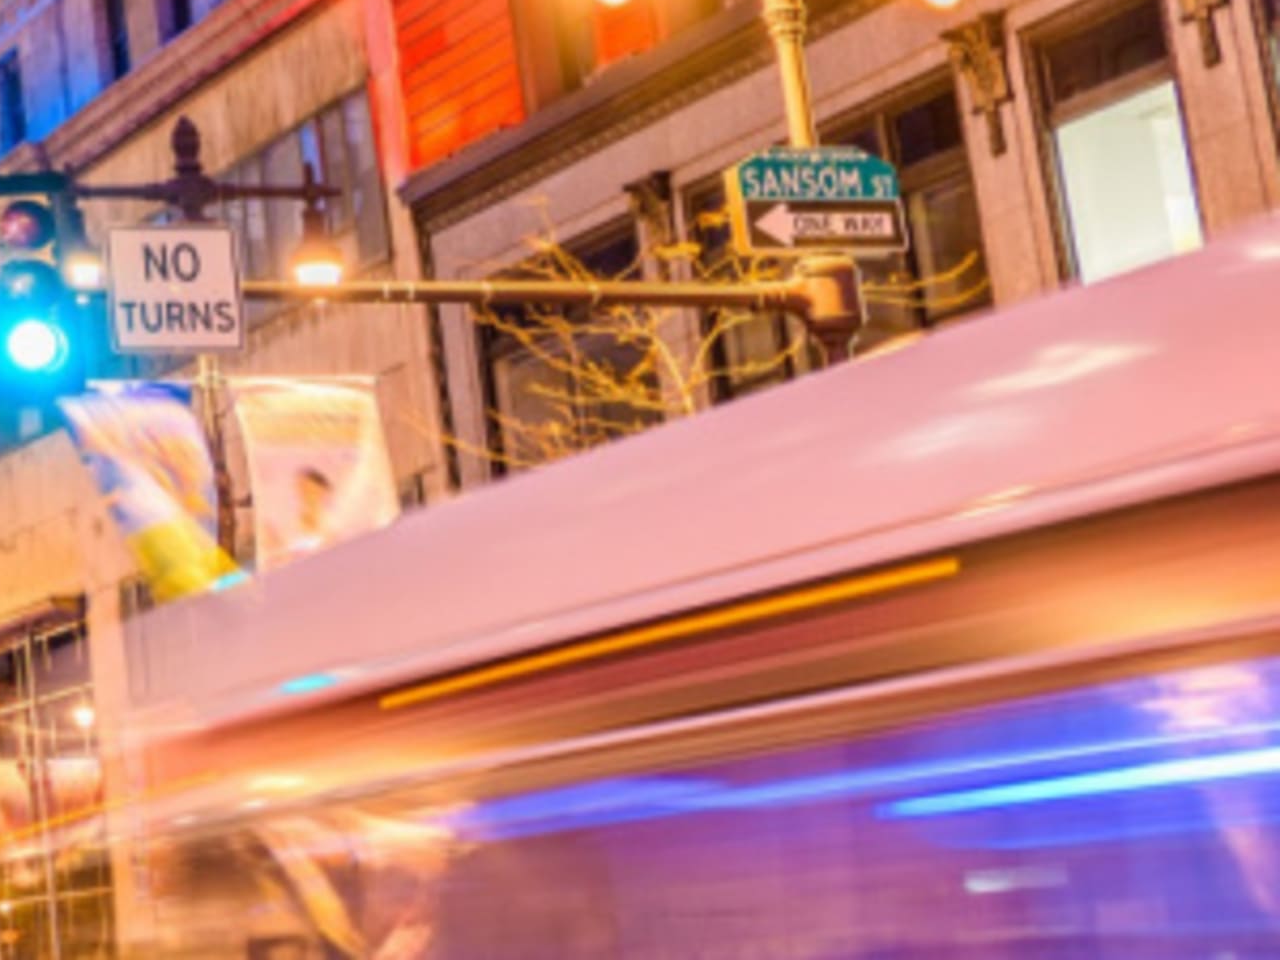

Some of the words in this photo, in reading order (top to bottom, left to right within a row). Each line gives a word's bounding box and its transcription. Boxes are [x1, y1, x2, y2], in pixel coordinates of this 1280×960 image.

[743, 164, 863, 198] SANSOM
[871, 174, 893, 198] ST
[793, 214, 831, 234] ONE
[843, 214, 885, 234] WAY
[143, 242, 202, 283] NO
[119, 301, 236, 333] TURNS
